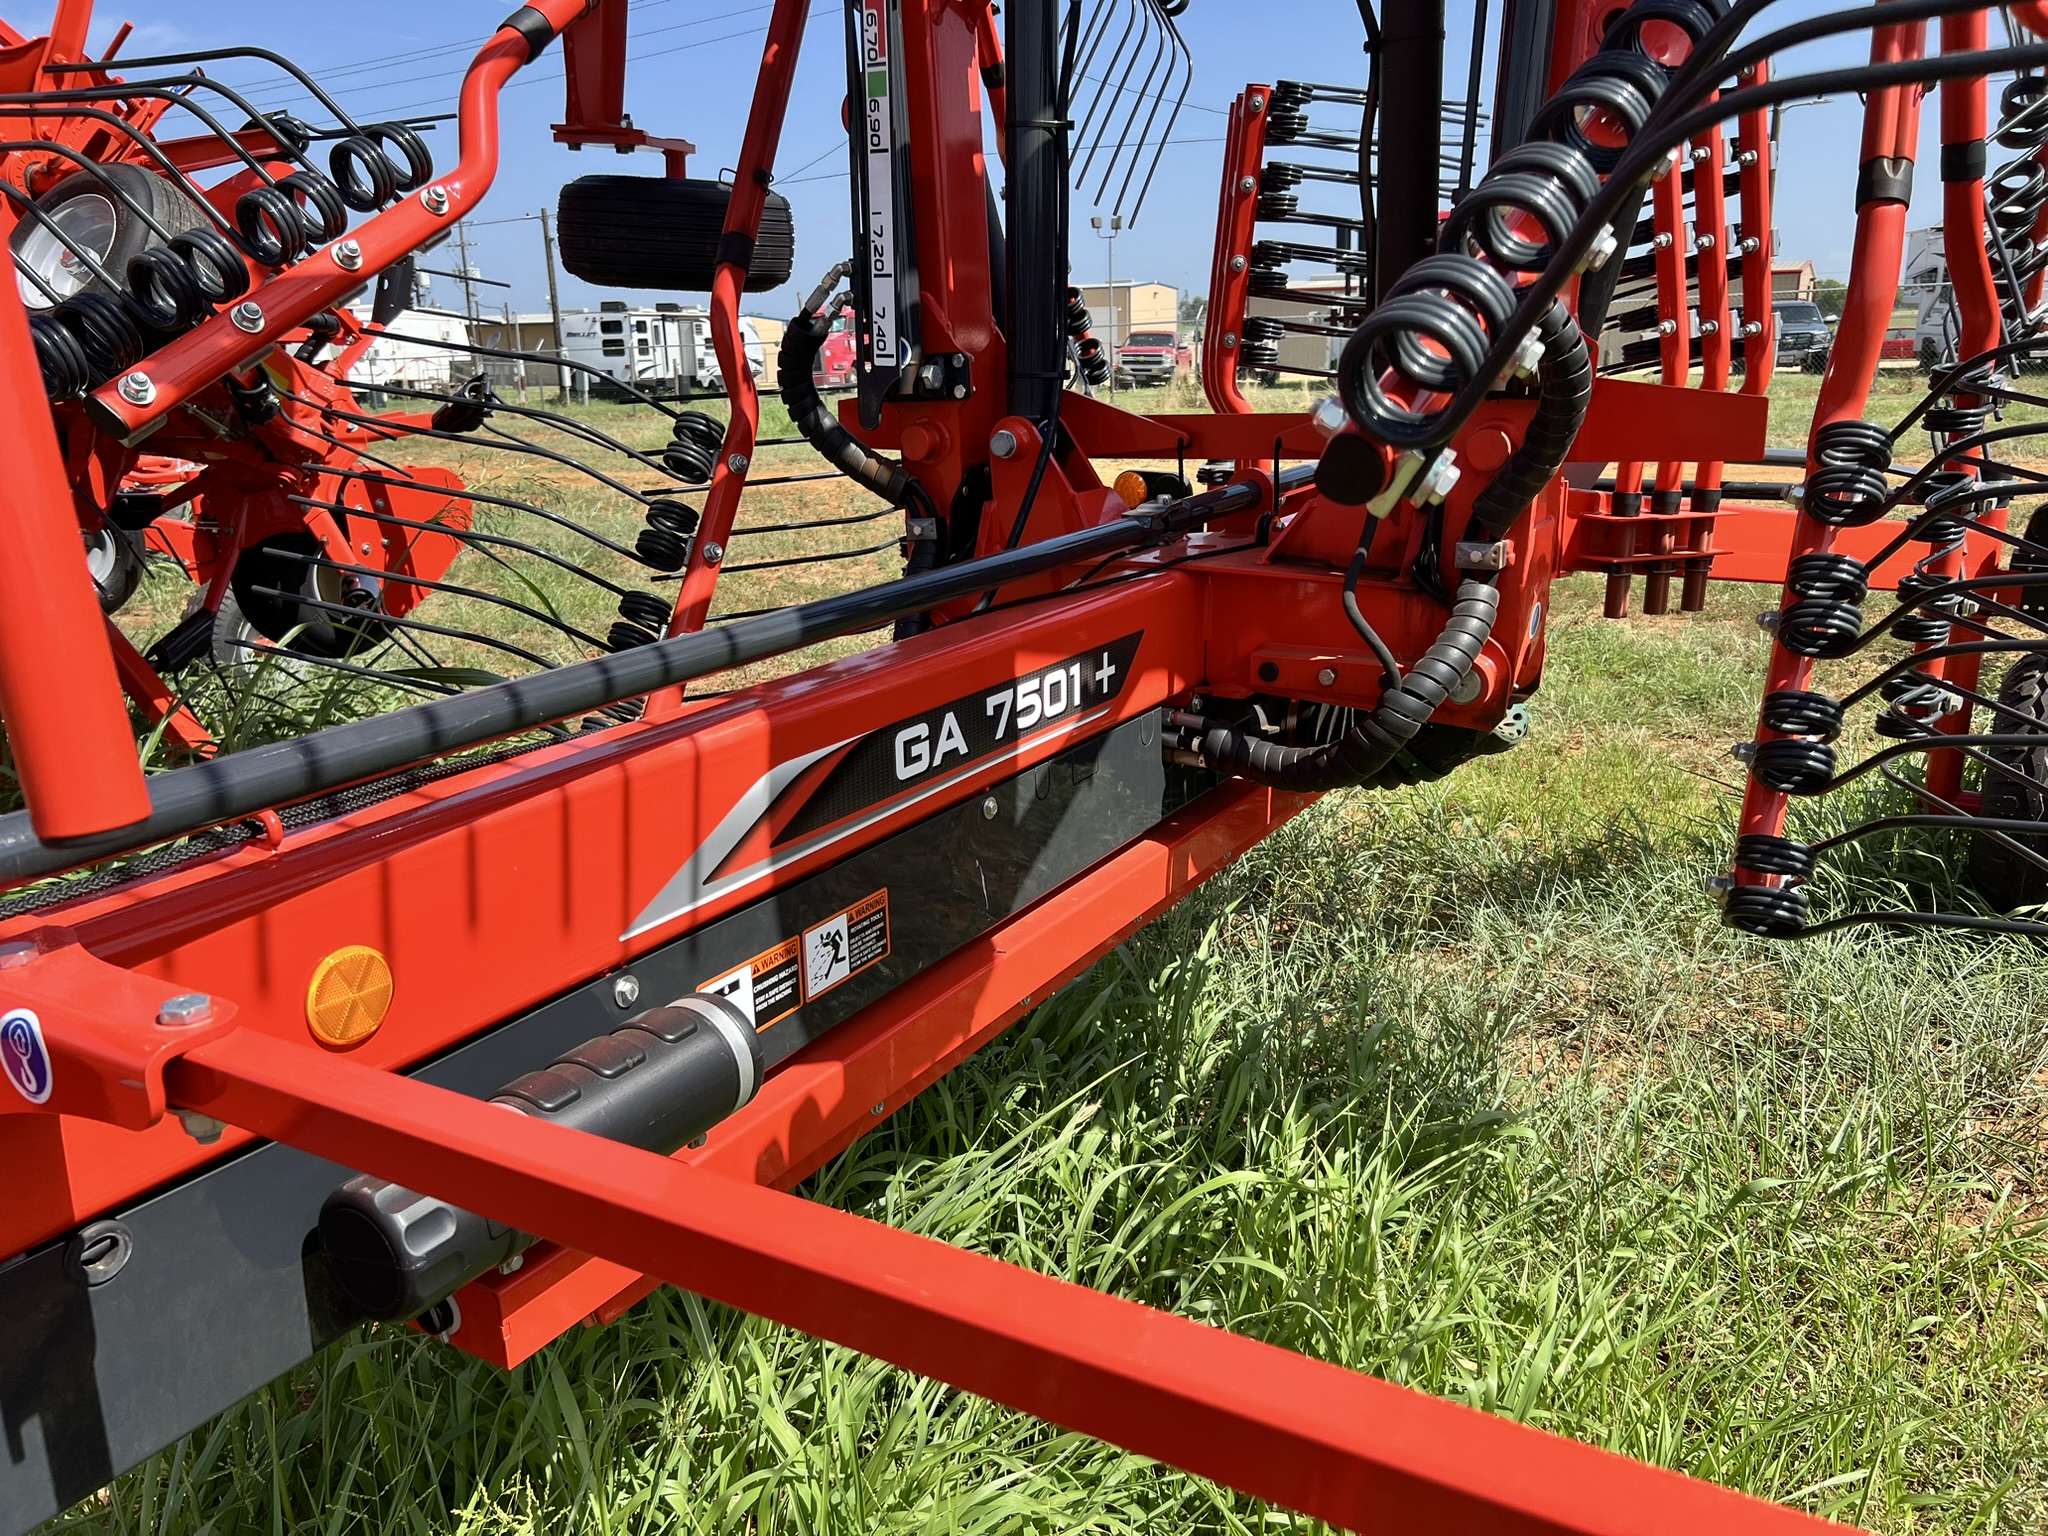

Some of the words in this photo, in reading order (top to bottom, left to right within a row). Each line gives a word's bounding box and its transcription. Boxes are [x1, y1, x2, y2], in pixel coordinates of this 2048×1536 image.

[865, 12, 879, 62] 6,70
[867, 98, 881, 148] 6,90
[871, 225, 884, 272] 7,20
[874, 306, 887, 352] 7,40
[895, 711, 969, 781] GA
[986, 662, 1081, 741] 7501
[850, 919, 870, 933] ROTATING
[870, 911, 883, 923] TOOLS
[854, 895, 885, 919] WARNING
[761, 943, 797, 970] WARNING
[753, 974, 779, 994] CRUSHING
[778, 963, 799, 979] HAZARD
[755, 994, 766, 1005] STAY
[769, 986, 779, 998] SAFE
[779, 976, 797, 992] DISTANCE
[755, 1001, 768, 1013] FROM
